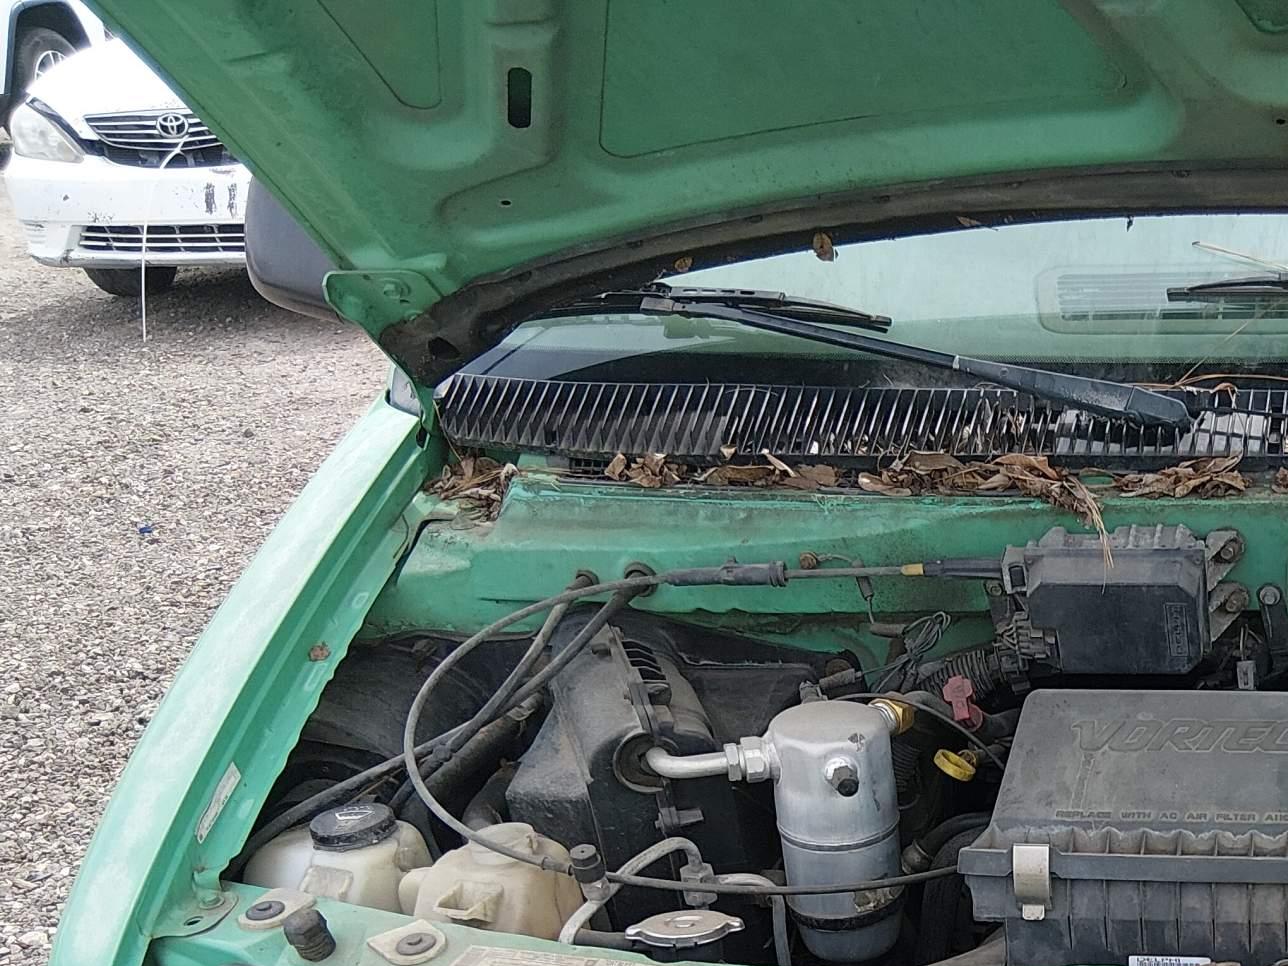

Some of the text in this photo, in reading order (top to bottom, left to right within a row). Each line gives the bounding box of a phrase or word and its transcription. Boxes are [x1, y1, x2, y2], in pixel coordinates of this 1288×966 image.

[1055, 810, 1112, 820] REPLACE
[1121, 811, 1152, 820] WITH
[1187, 812, 1208, 822] AIR
[1216, 812, 1256, 822] FILTER
